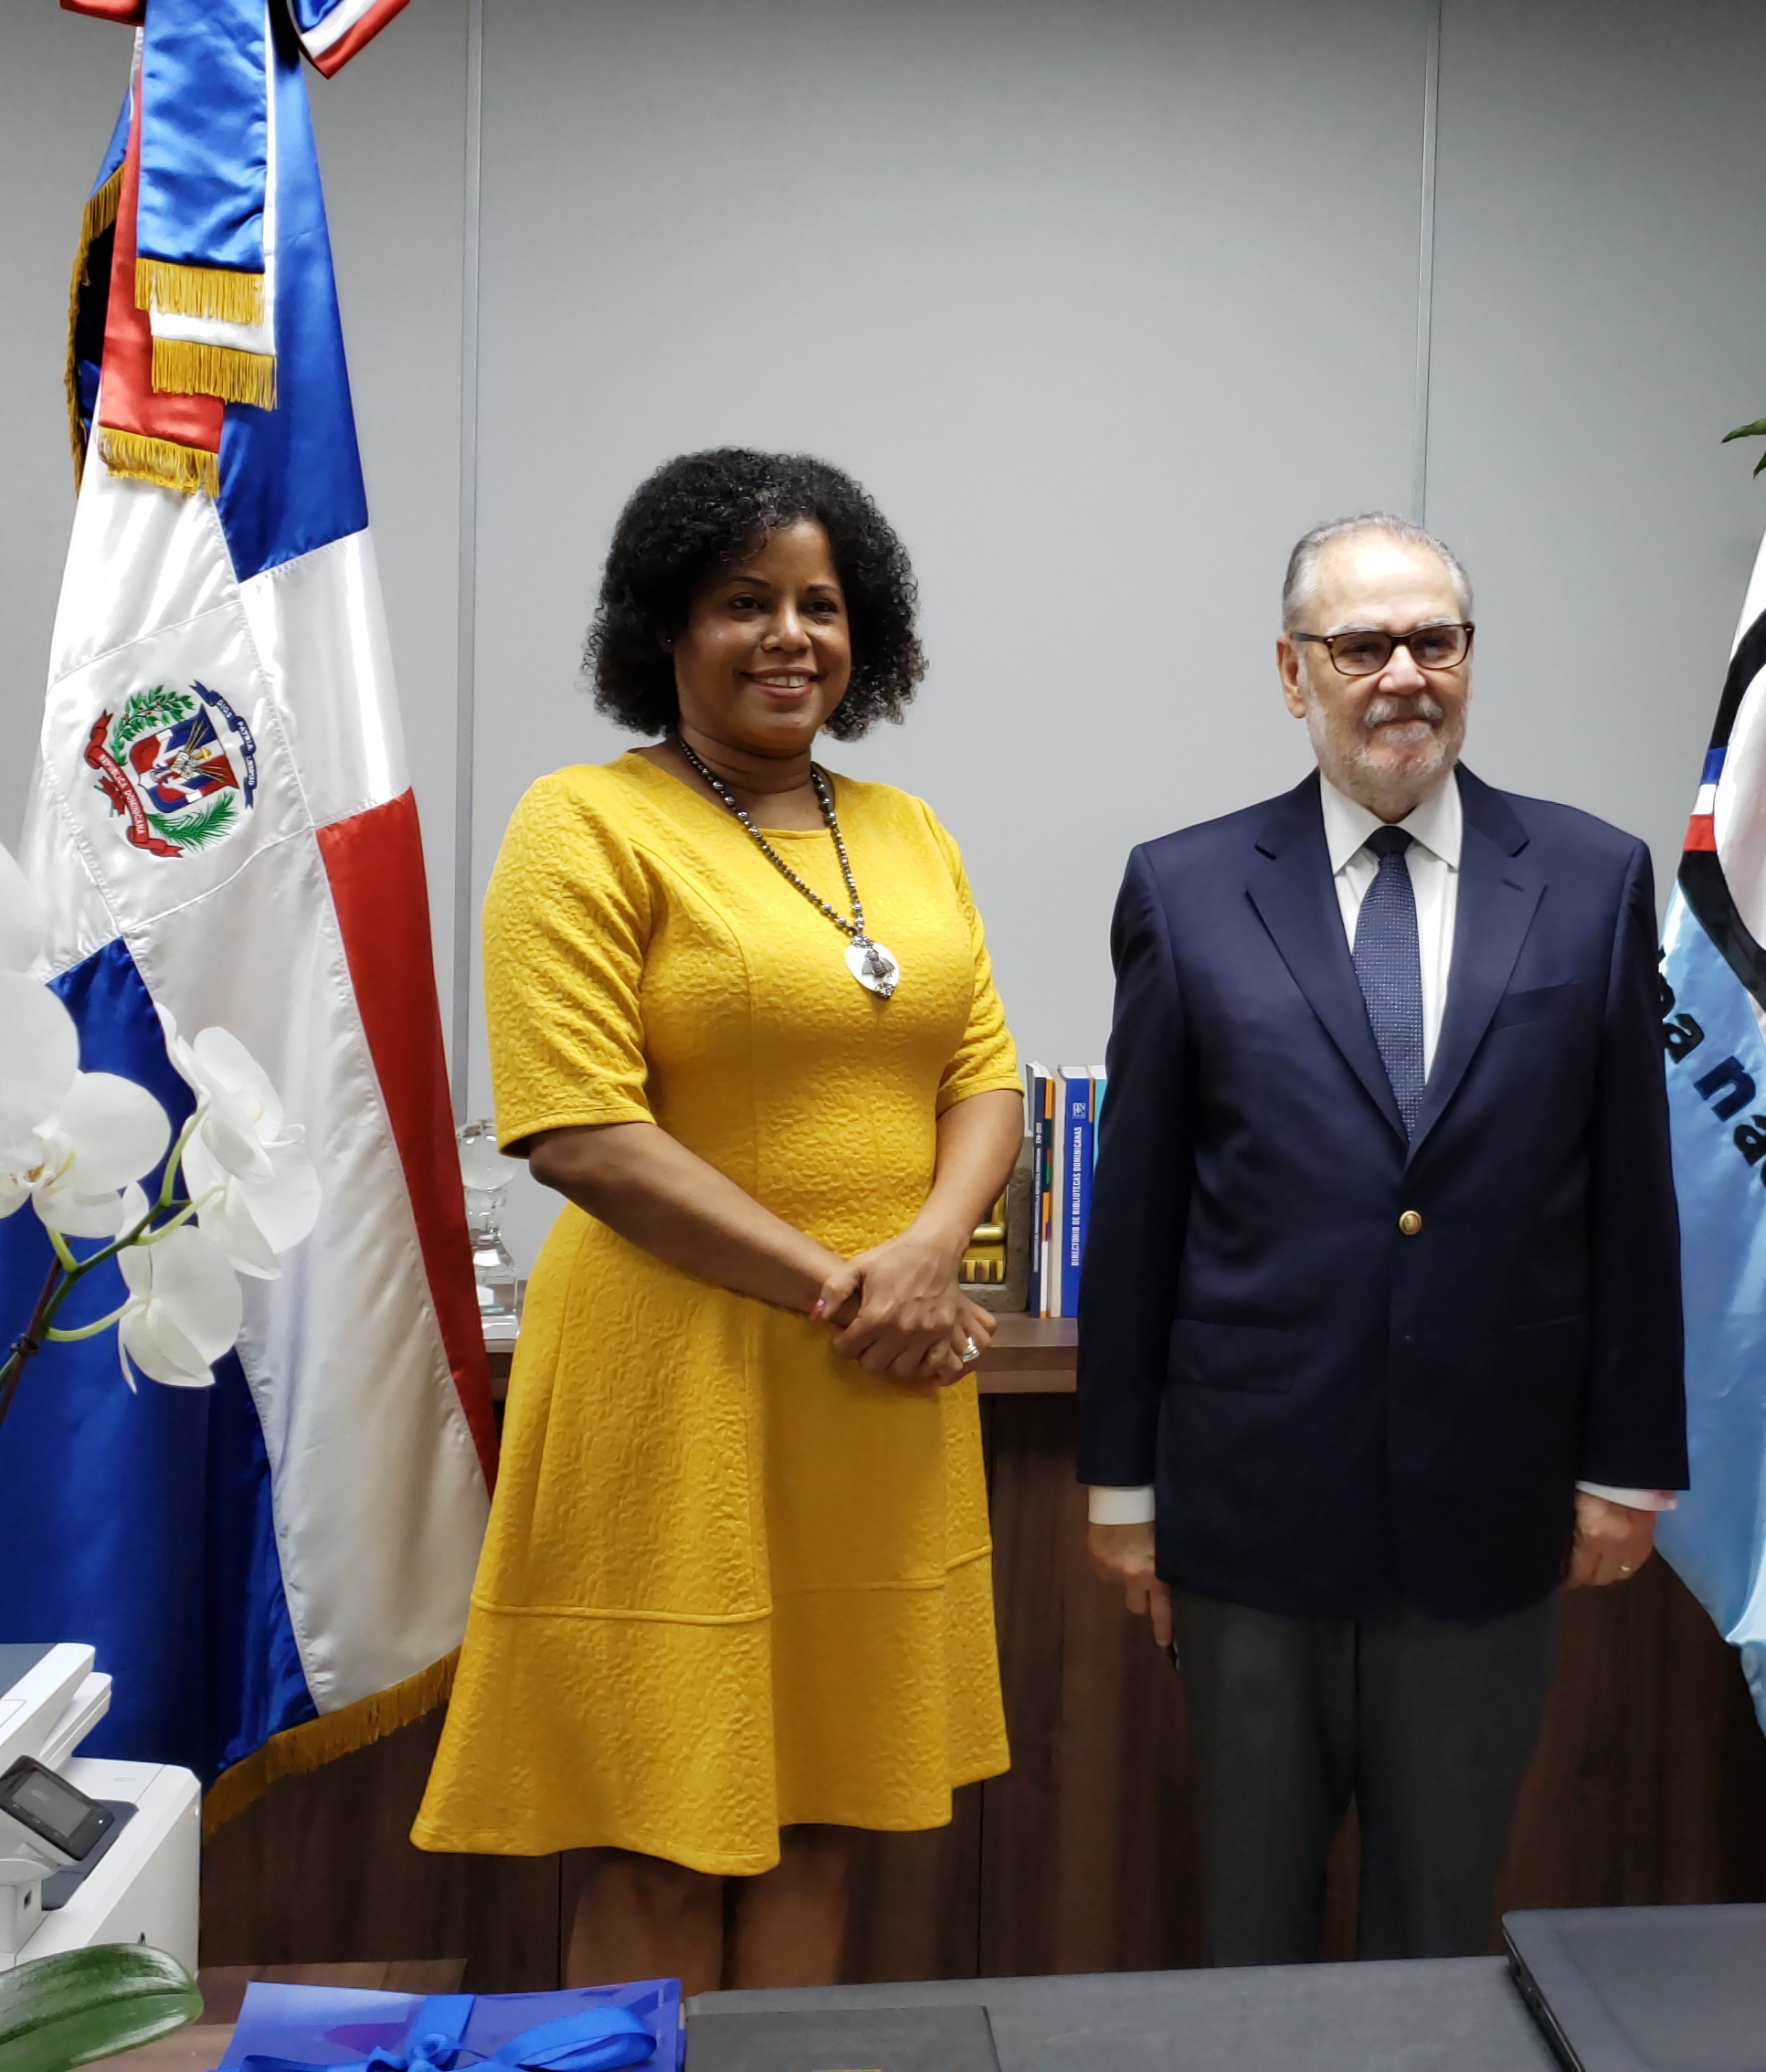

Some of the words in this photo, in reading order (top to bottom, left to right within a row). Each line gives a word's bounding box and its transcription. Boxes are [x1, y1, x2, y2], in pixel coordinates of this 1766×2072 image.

[217, 699, 233, 719] DIOS
[238, 720, 254, 752] PATRIA
[123, 788, 146, 835] DOMINICANA
[1073, 1126, 1083, 1172] DOMINICANAS
[1072, 1172, 1082, 1215] BIBLIOTECAS
[1072, 1215, 1081, 1225] DE
[1071, 1226, 1080, 1267] DIRECTORIO
